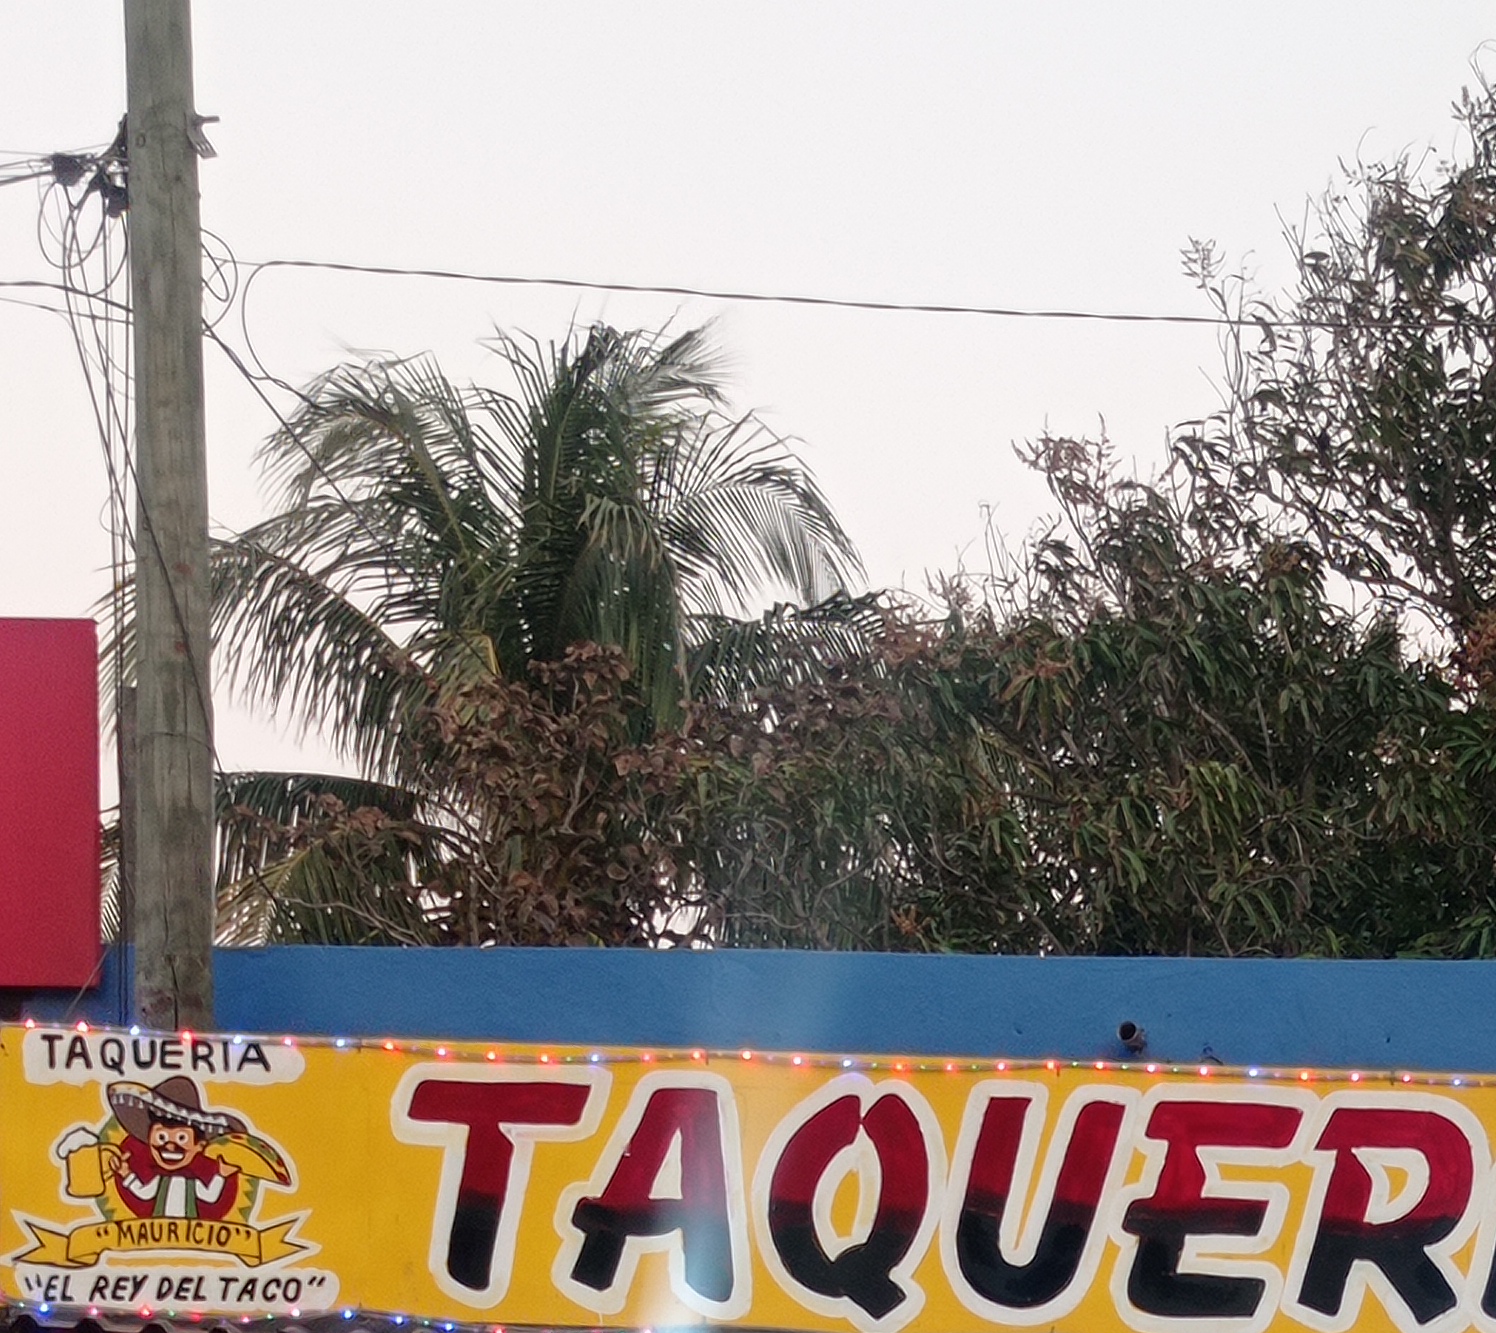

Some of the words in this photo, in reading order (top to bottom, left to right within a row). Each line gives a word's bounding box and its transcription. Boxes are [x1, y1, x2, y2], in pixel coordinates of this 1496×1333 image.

[40, 1033, 271, 1075] TAQUERIA
[88, 1274, 149, 1302] REY
[156, 1275, 208, 1302] DEL
